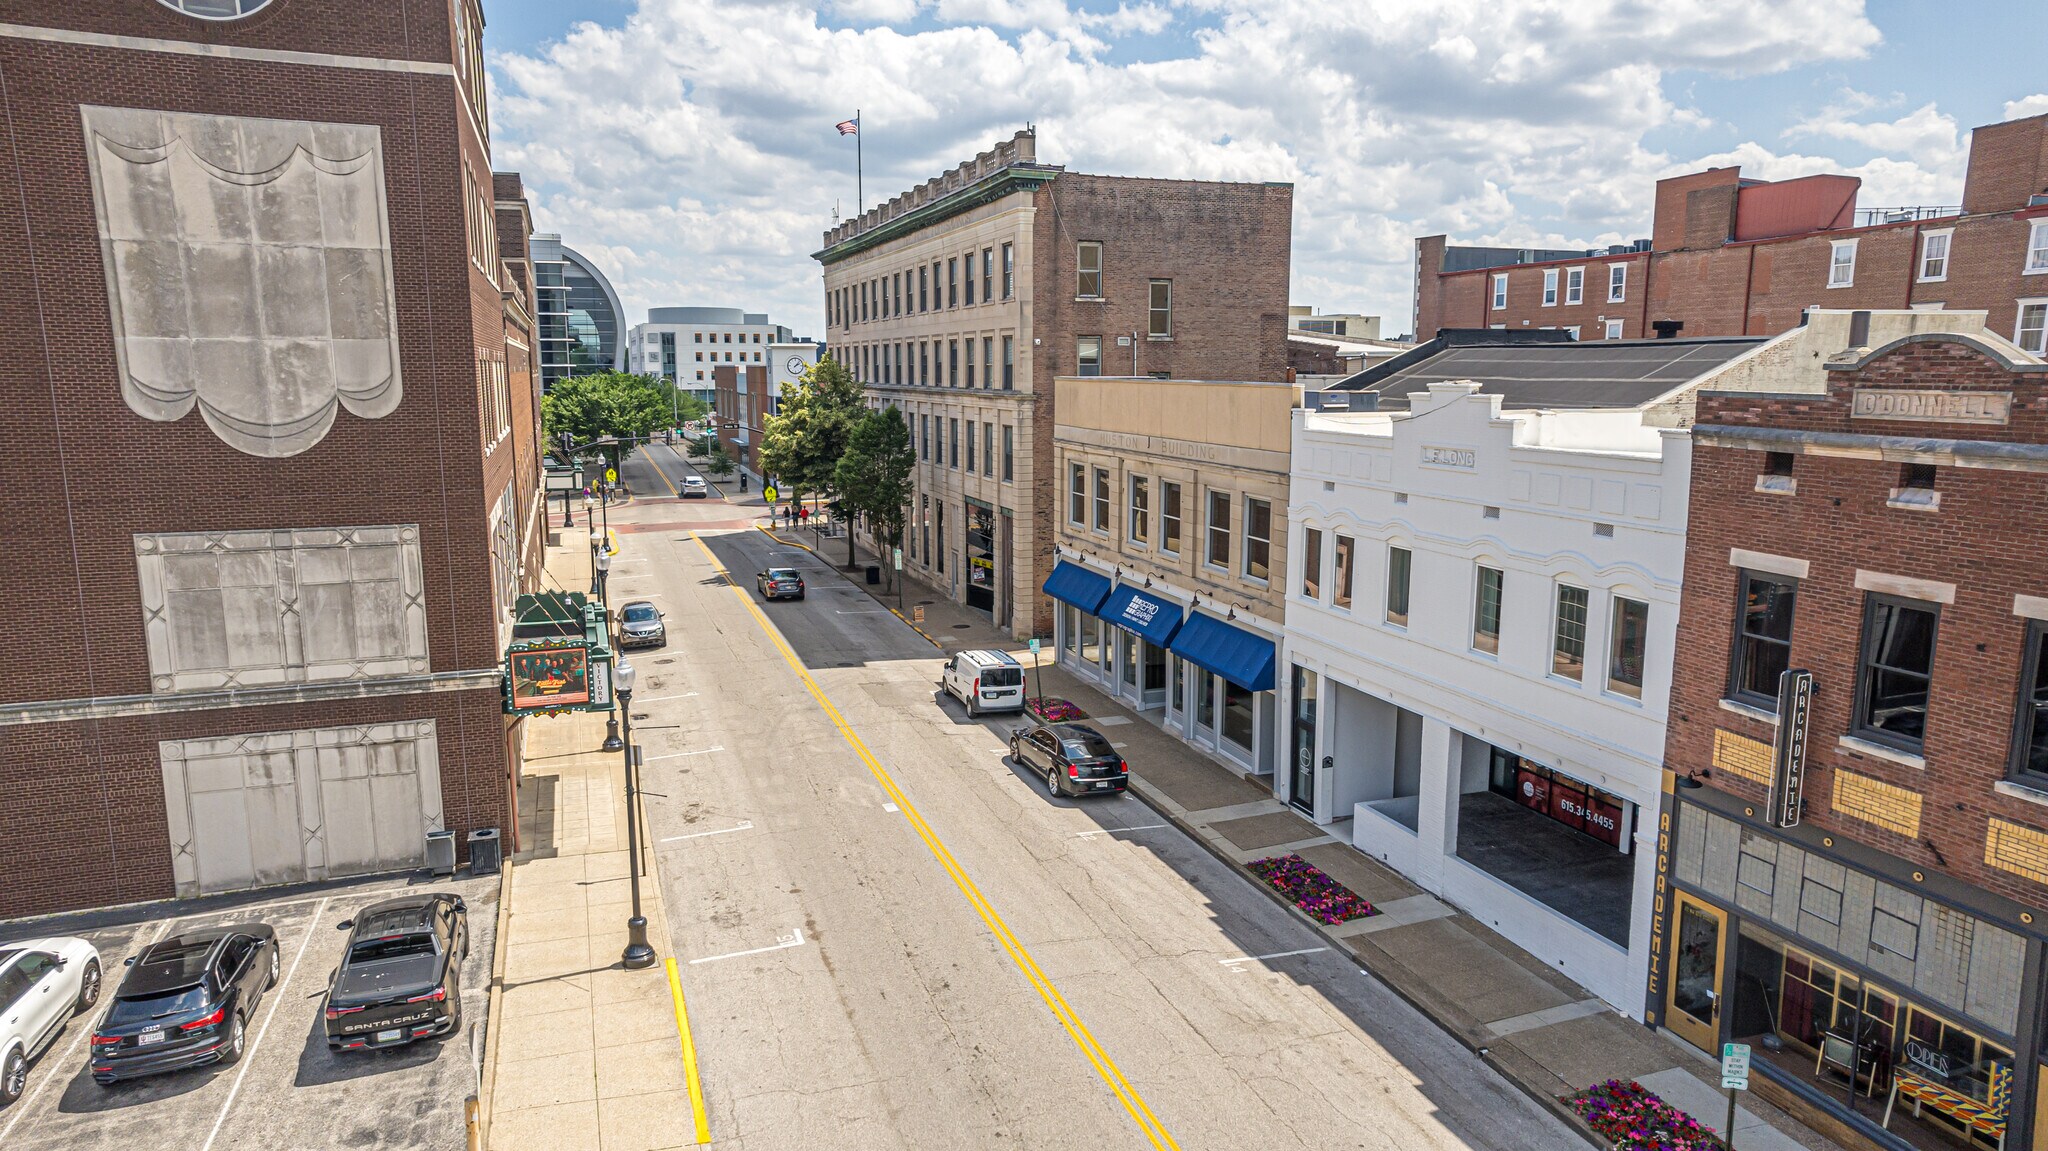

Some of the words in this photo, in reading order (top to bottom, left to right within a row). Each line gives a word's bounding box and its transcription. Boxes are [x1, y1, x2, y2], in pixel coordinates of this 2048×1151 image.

[1863, 394, 1993, 418] O'DONNELL
[1161, 440, 1216, 460] BUILDING
[1138, 600, 1159, 615] REPRO
[596, 663, 604, 702] VICTORY
[1787, 679, 1808, 821] ARCADEMIE
[1649, 812, 1670, 994] ARCADEMIE
[344, 1019, 390, 1032] SANTA
[393, 1011, 430, 1024] CRUZ
[1907, 1041, 1949, 1076] OPEN
